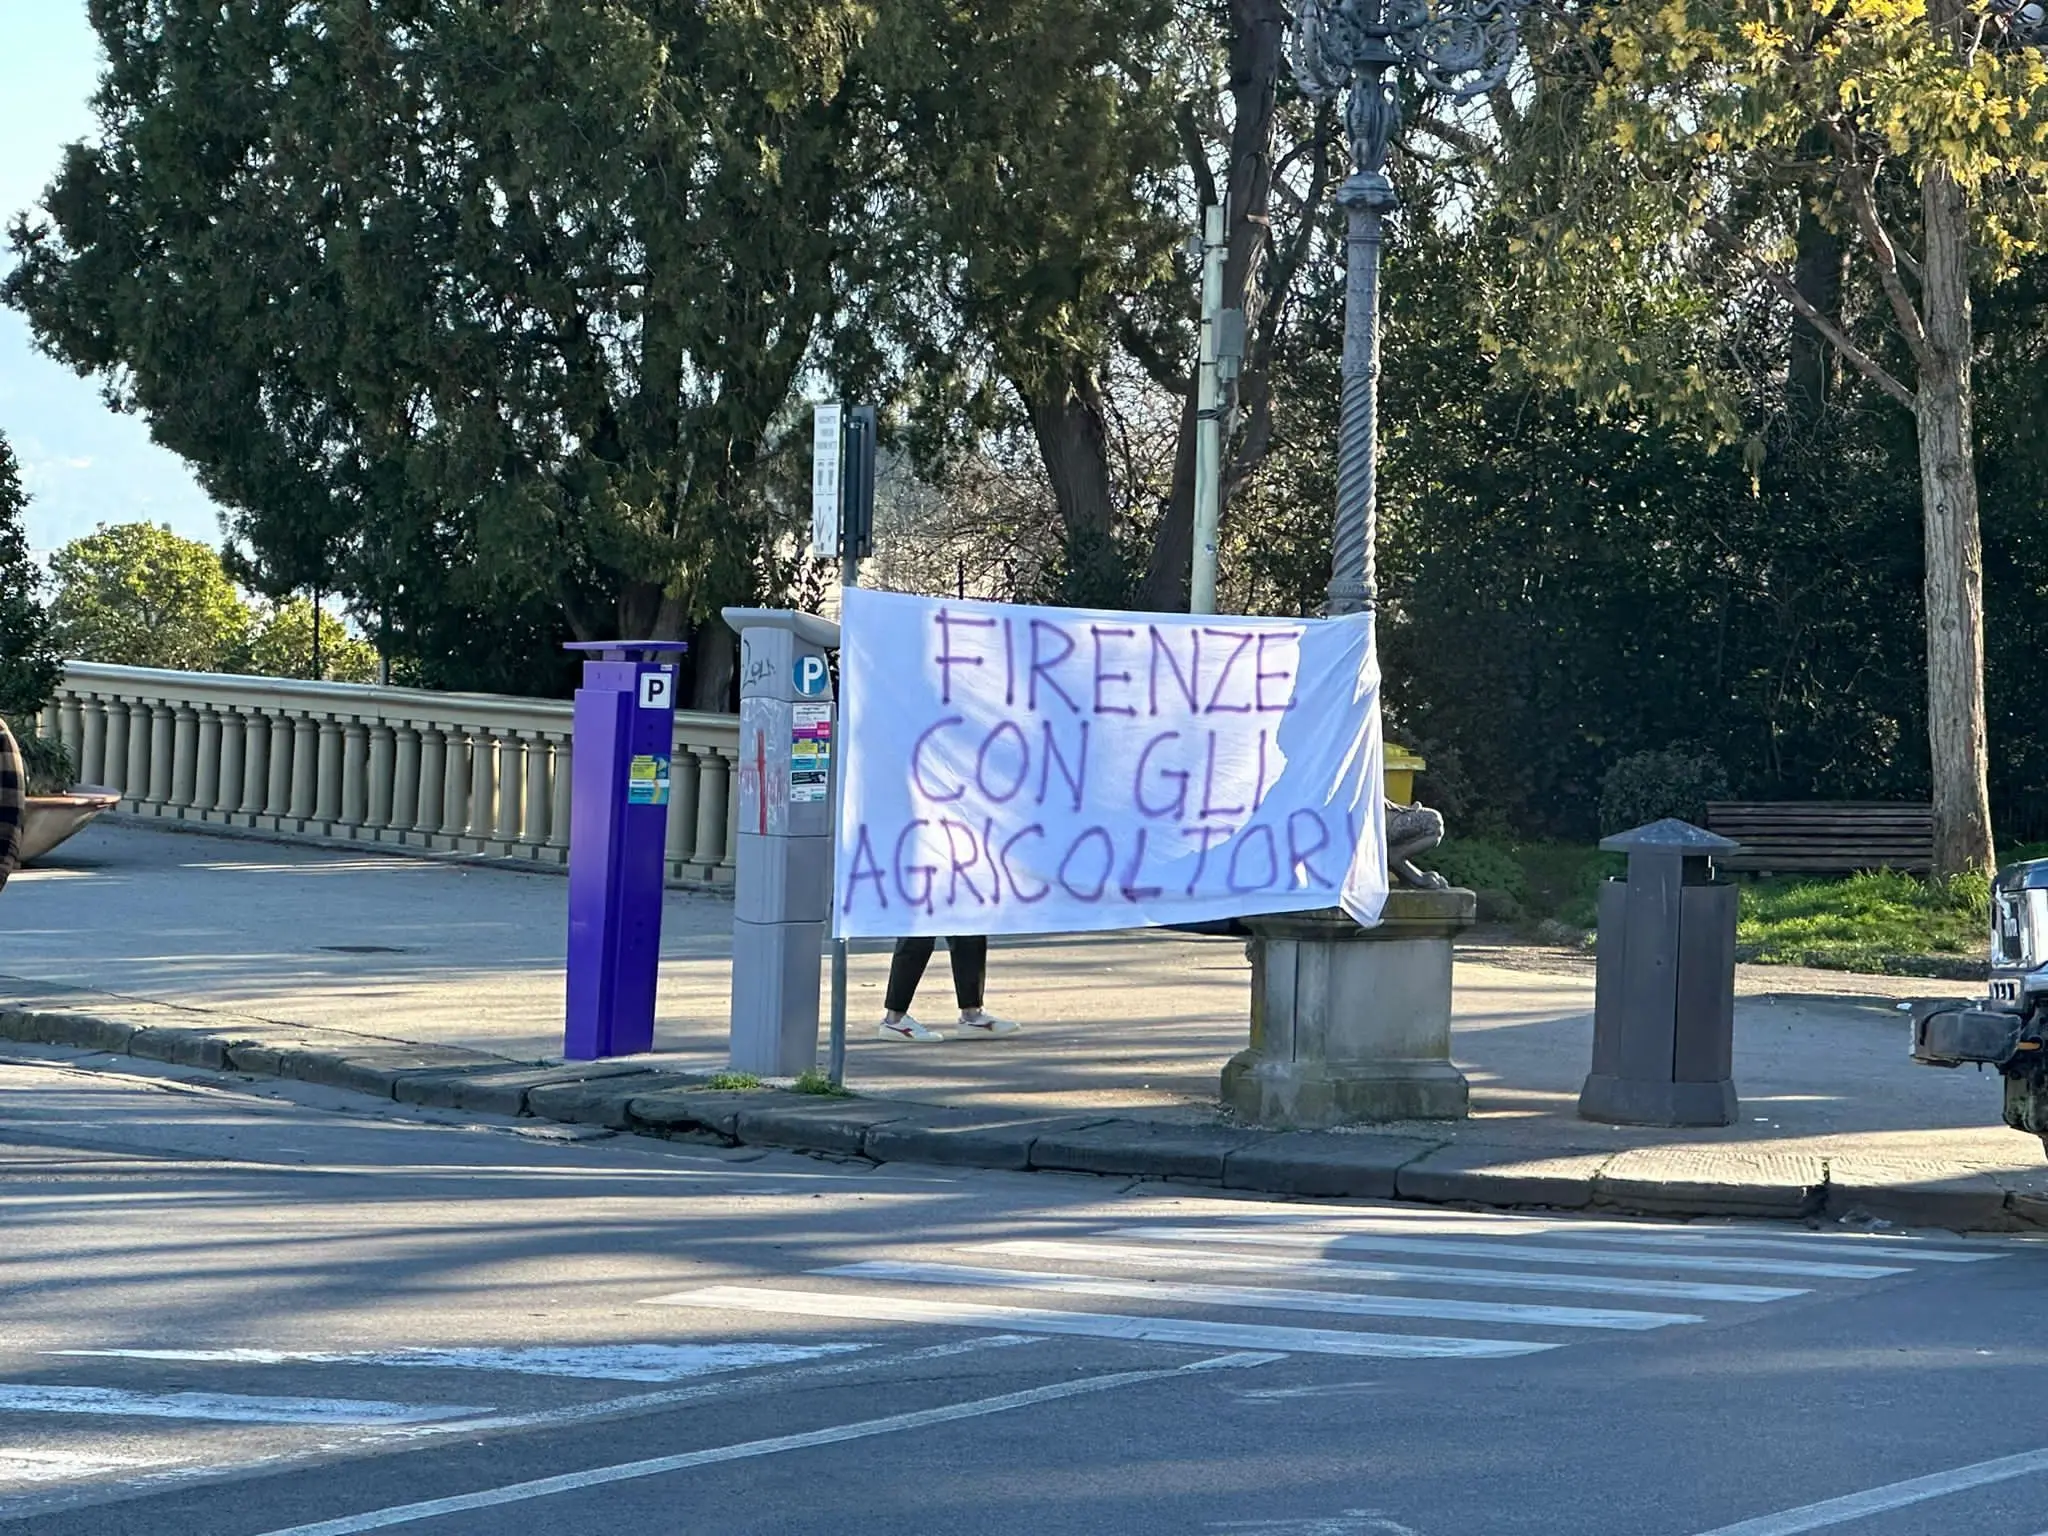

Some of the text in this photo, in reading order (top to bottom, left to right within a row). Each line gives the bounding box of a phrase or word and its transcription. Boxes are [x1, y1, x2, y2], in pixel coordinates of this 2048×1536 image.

[647, 679, 664, 702] P
[803, 656, 823, 694] P
[934, 607, 1299, 717] FIRENZE
[911, 716, 1267, 820] CON GLI
[842, 807, 1358, 915] AGRICOLTORI
